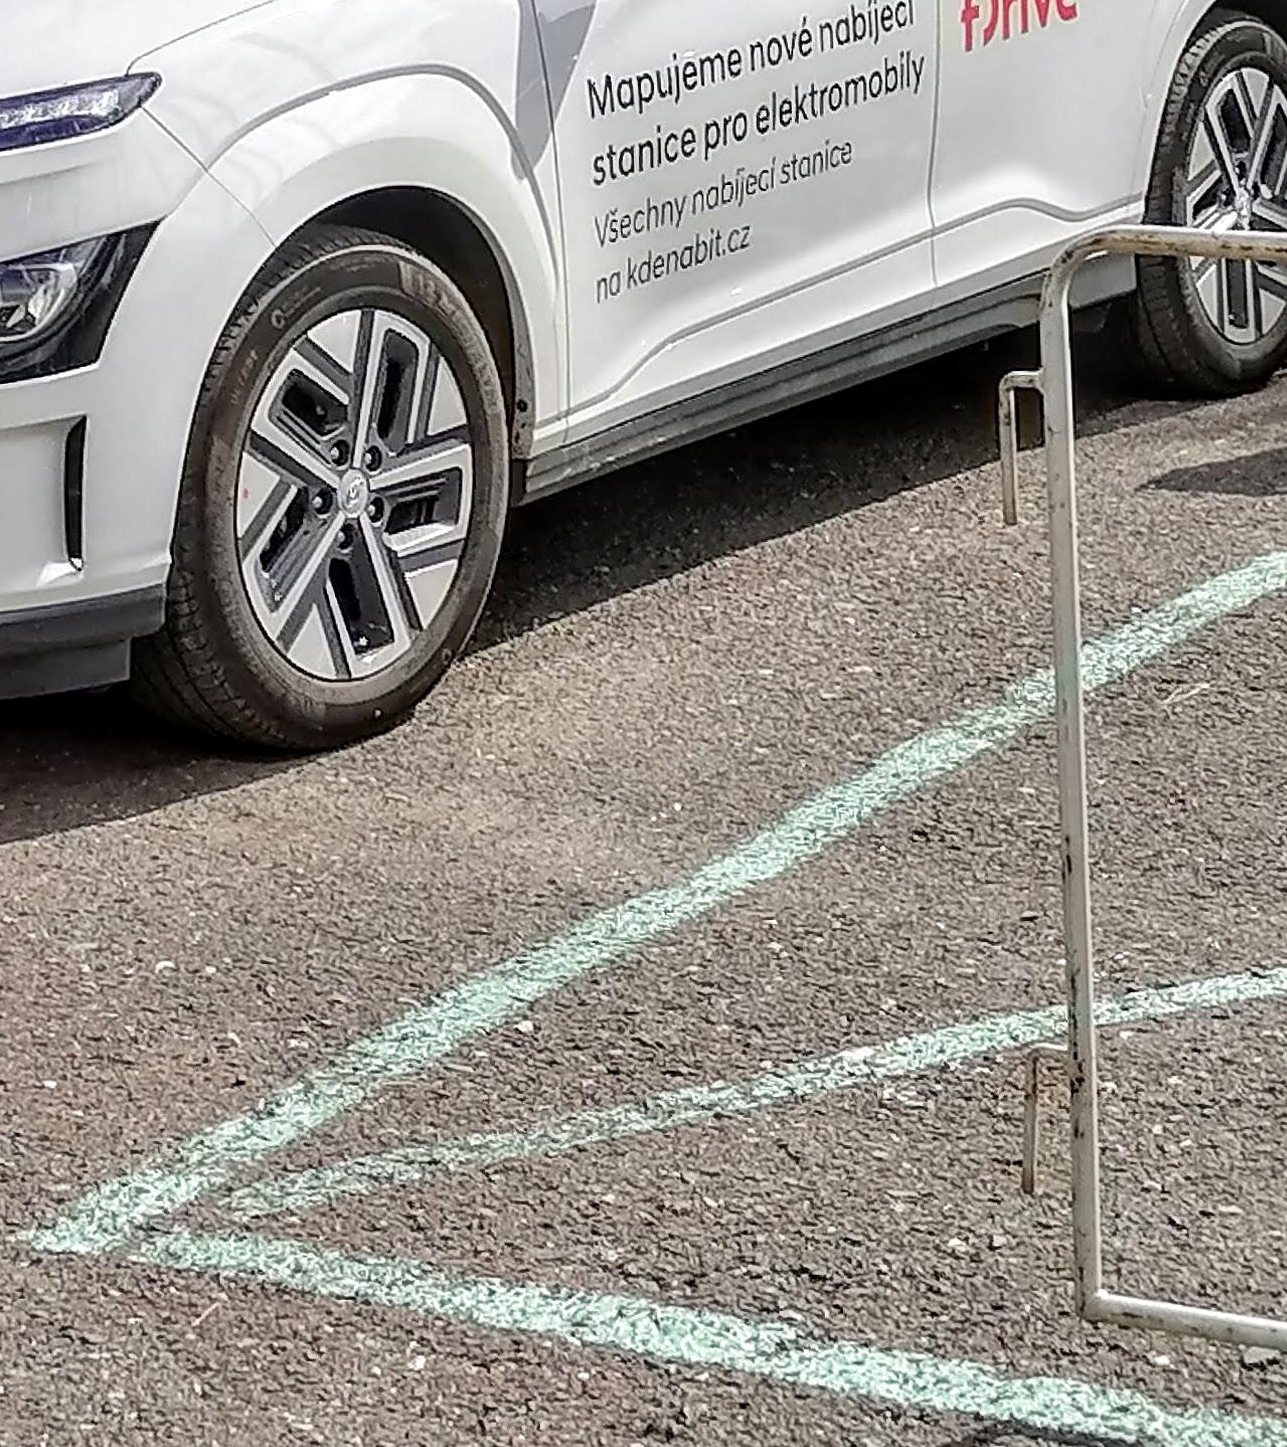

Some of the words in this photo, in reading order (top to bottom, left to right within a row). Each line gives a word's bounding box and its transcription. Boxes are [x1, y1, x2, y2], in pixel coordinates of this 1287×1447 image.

[586, 52, 743, 120] Mapujeme
[749, 16, 814, 72] nové
[592, 124, 697, 186] stanice
[704, 112, 748, 161] pro
[755, 50, 925, 136] elektromobily
[593, 197, 687, 248] Všechny
[691, 156, 777, 216] nabíjecí
[779, 138, 853, 185] stanice
[595, 270, 621, 304] na
[626, 225, 752, 287] kdenabit.cz
